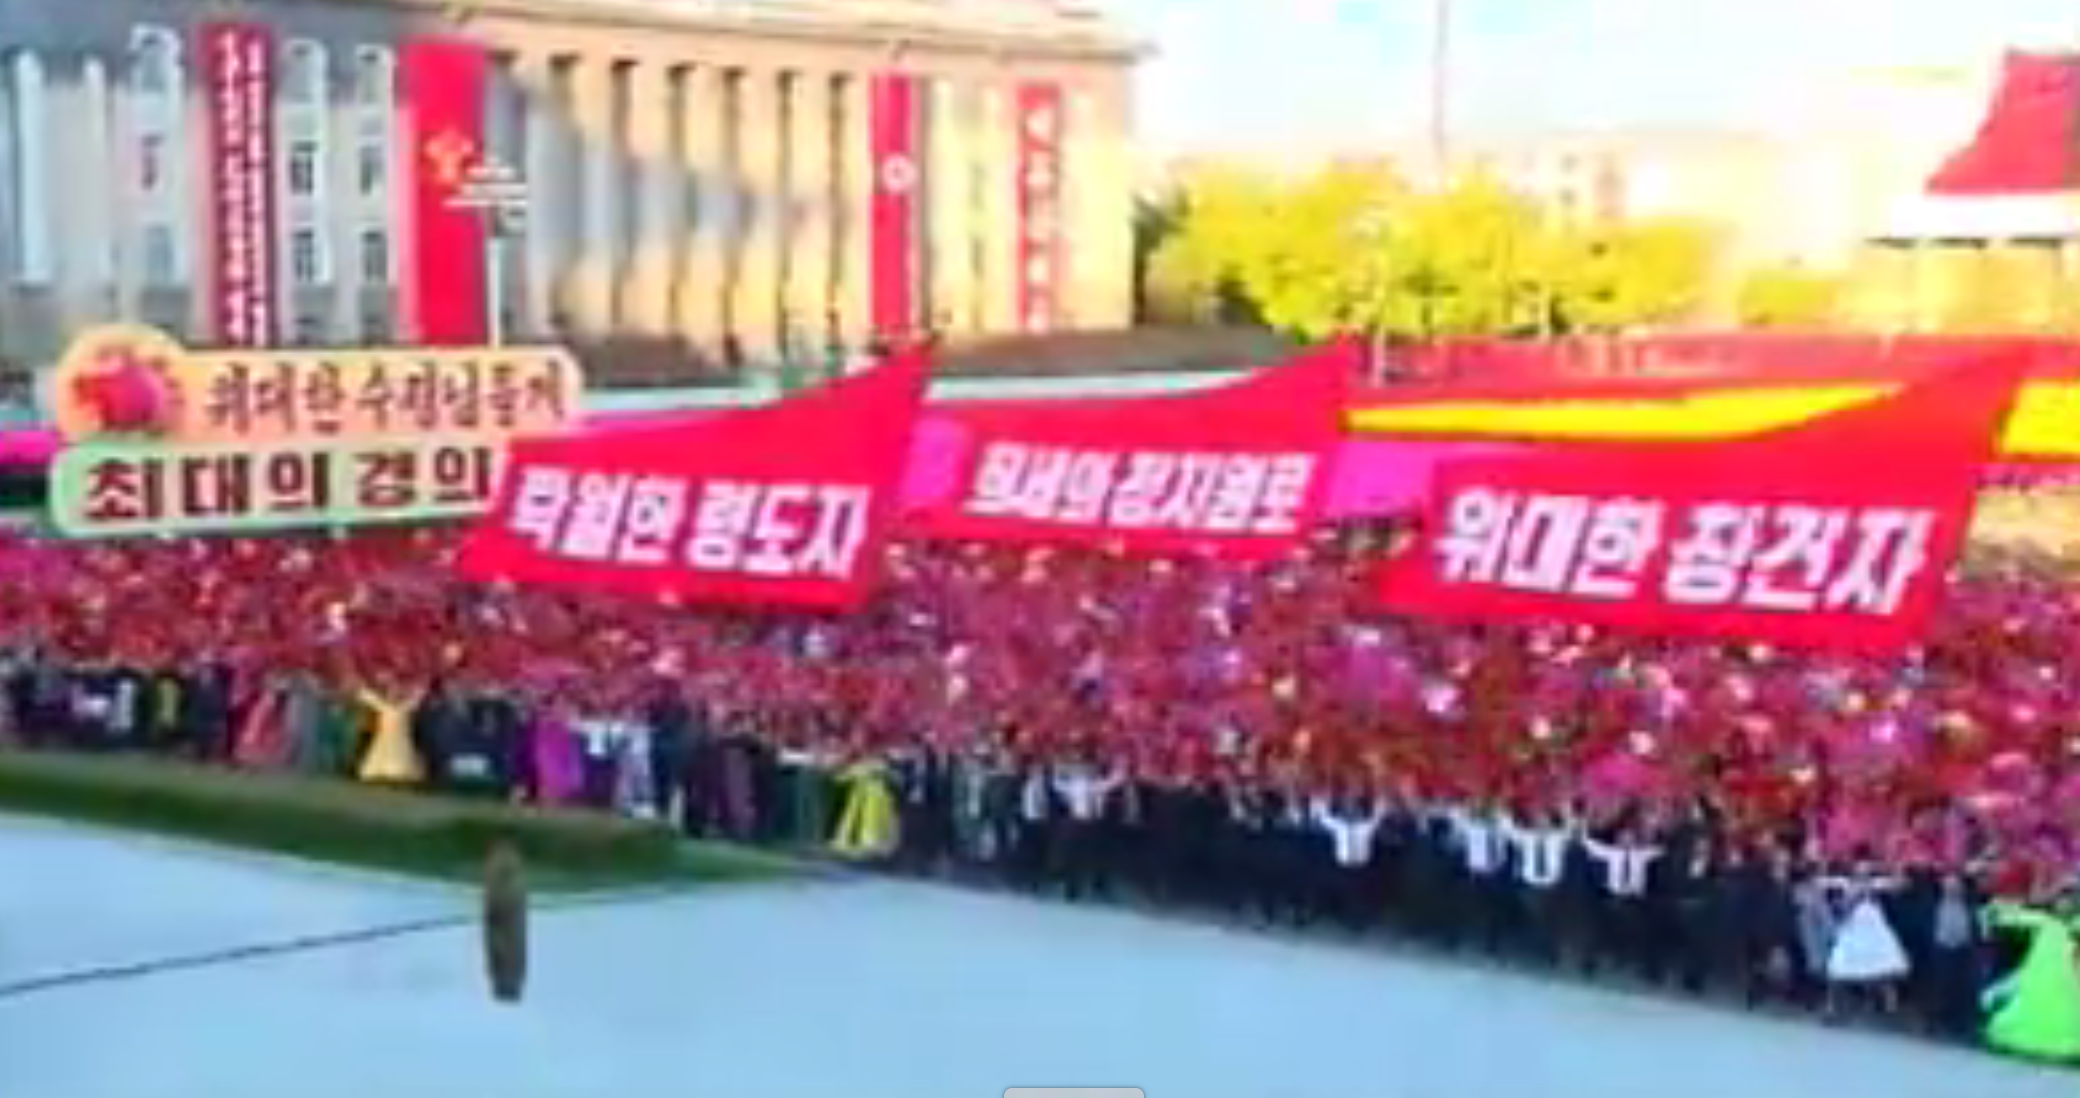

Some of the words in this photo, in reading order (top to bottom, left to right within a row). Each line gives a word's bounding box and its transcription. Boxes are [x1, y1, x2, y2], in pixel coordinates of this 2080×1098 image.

[205, 361, 345, 435] 위대한
[86, 451, 331, 522] 최대의
[507, 464, 690, 563] 탁월한
[686, 478, 870, 580] 령도자
[1433, 487, 1665, 599] 위대한
[1662, 501, 1936, 615] 창건자
